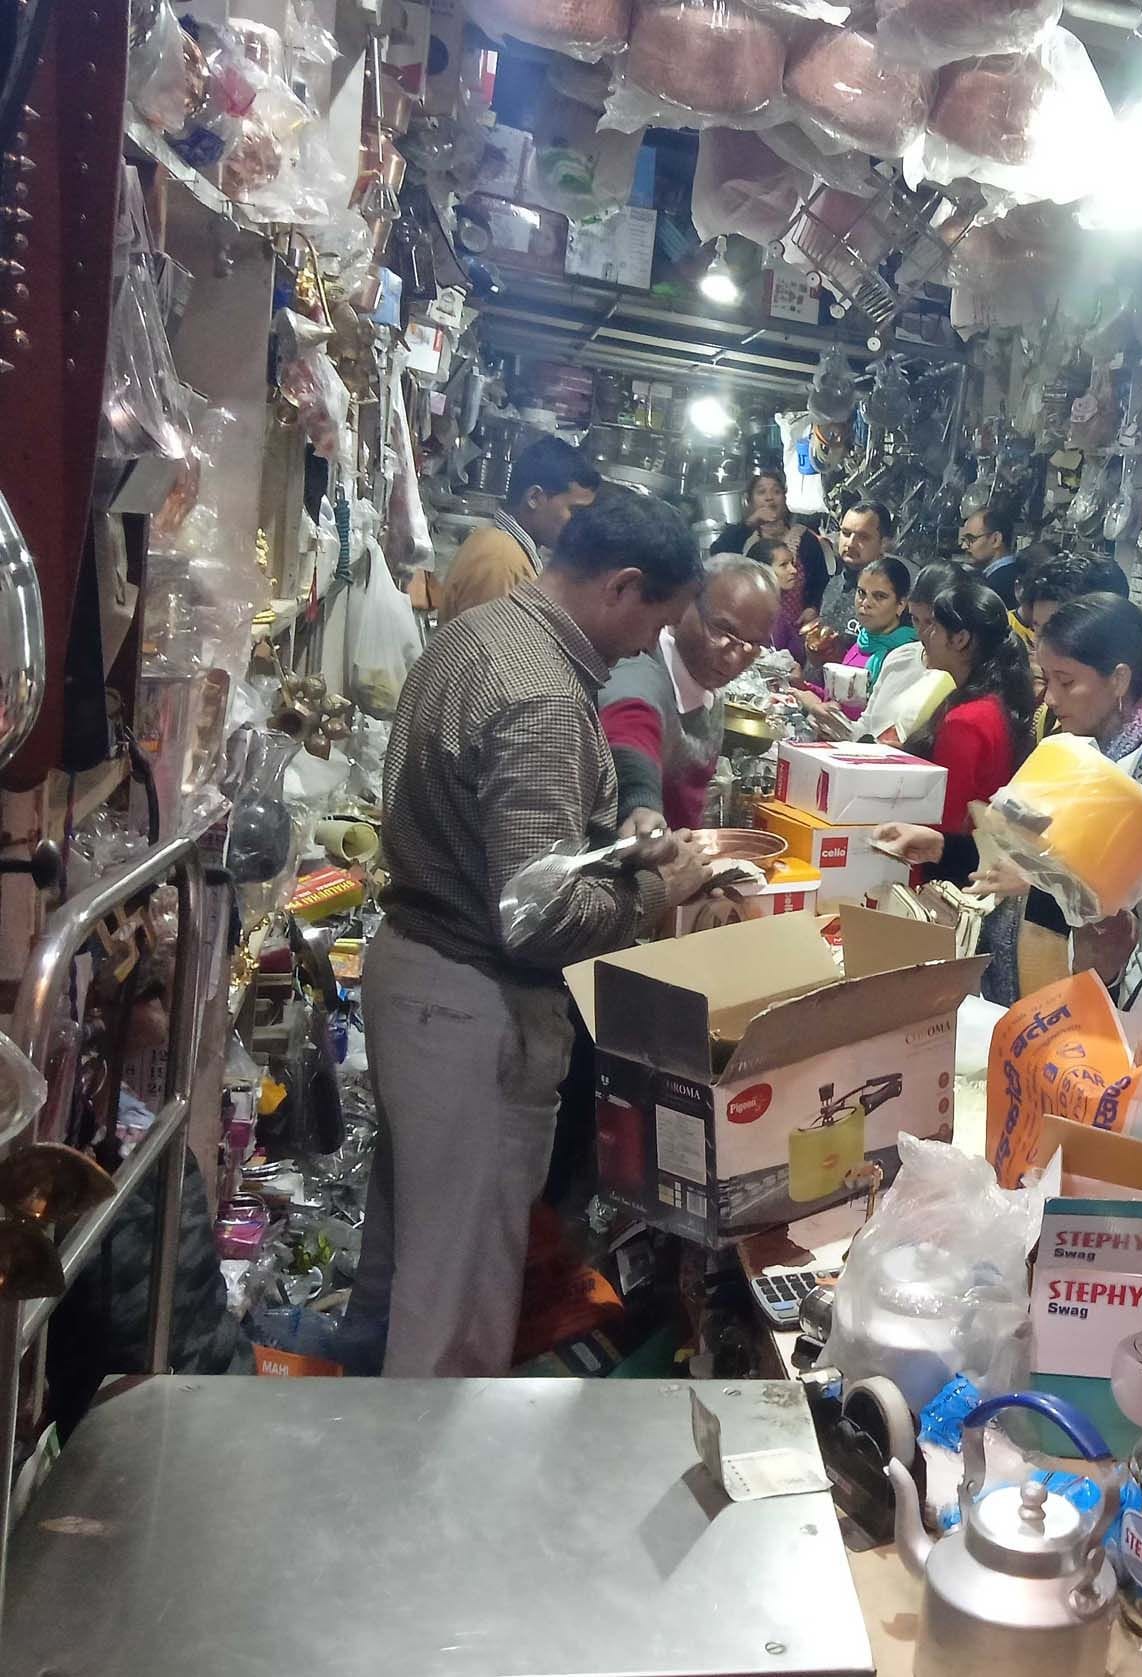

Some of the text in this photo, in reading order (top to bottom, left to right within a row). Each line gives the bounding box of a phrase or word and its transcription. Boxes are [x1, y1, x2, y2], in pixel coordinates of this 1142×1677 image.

[821, 846, 846, 858] cello
[1054, 1247, 1096, 1261] Swag
[1047, 1302, 1089, 1319] Swag
